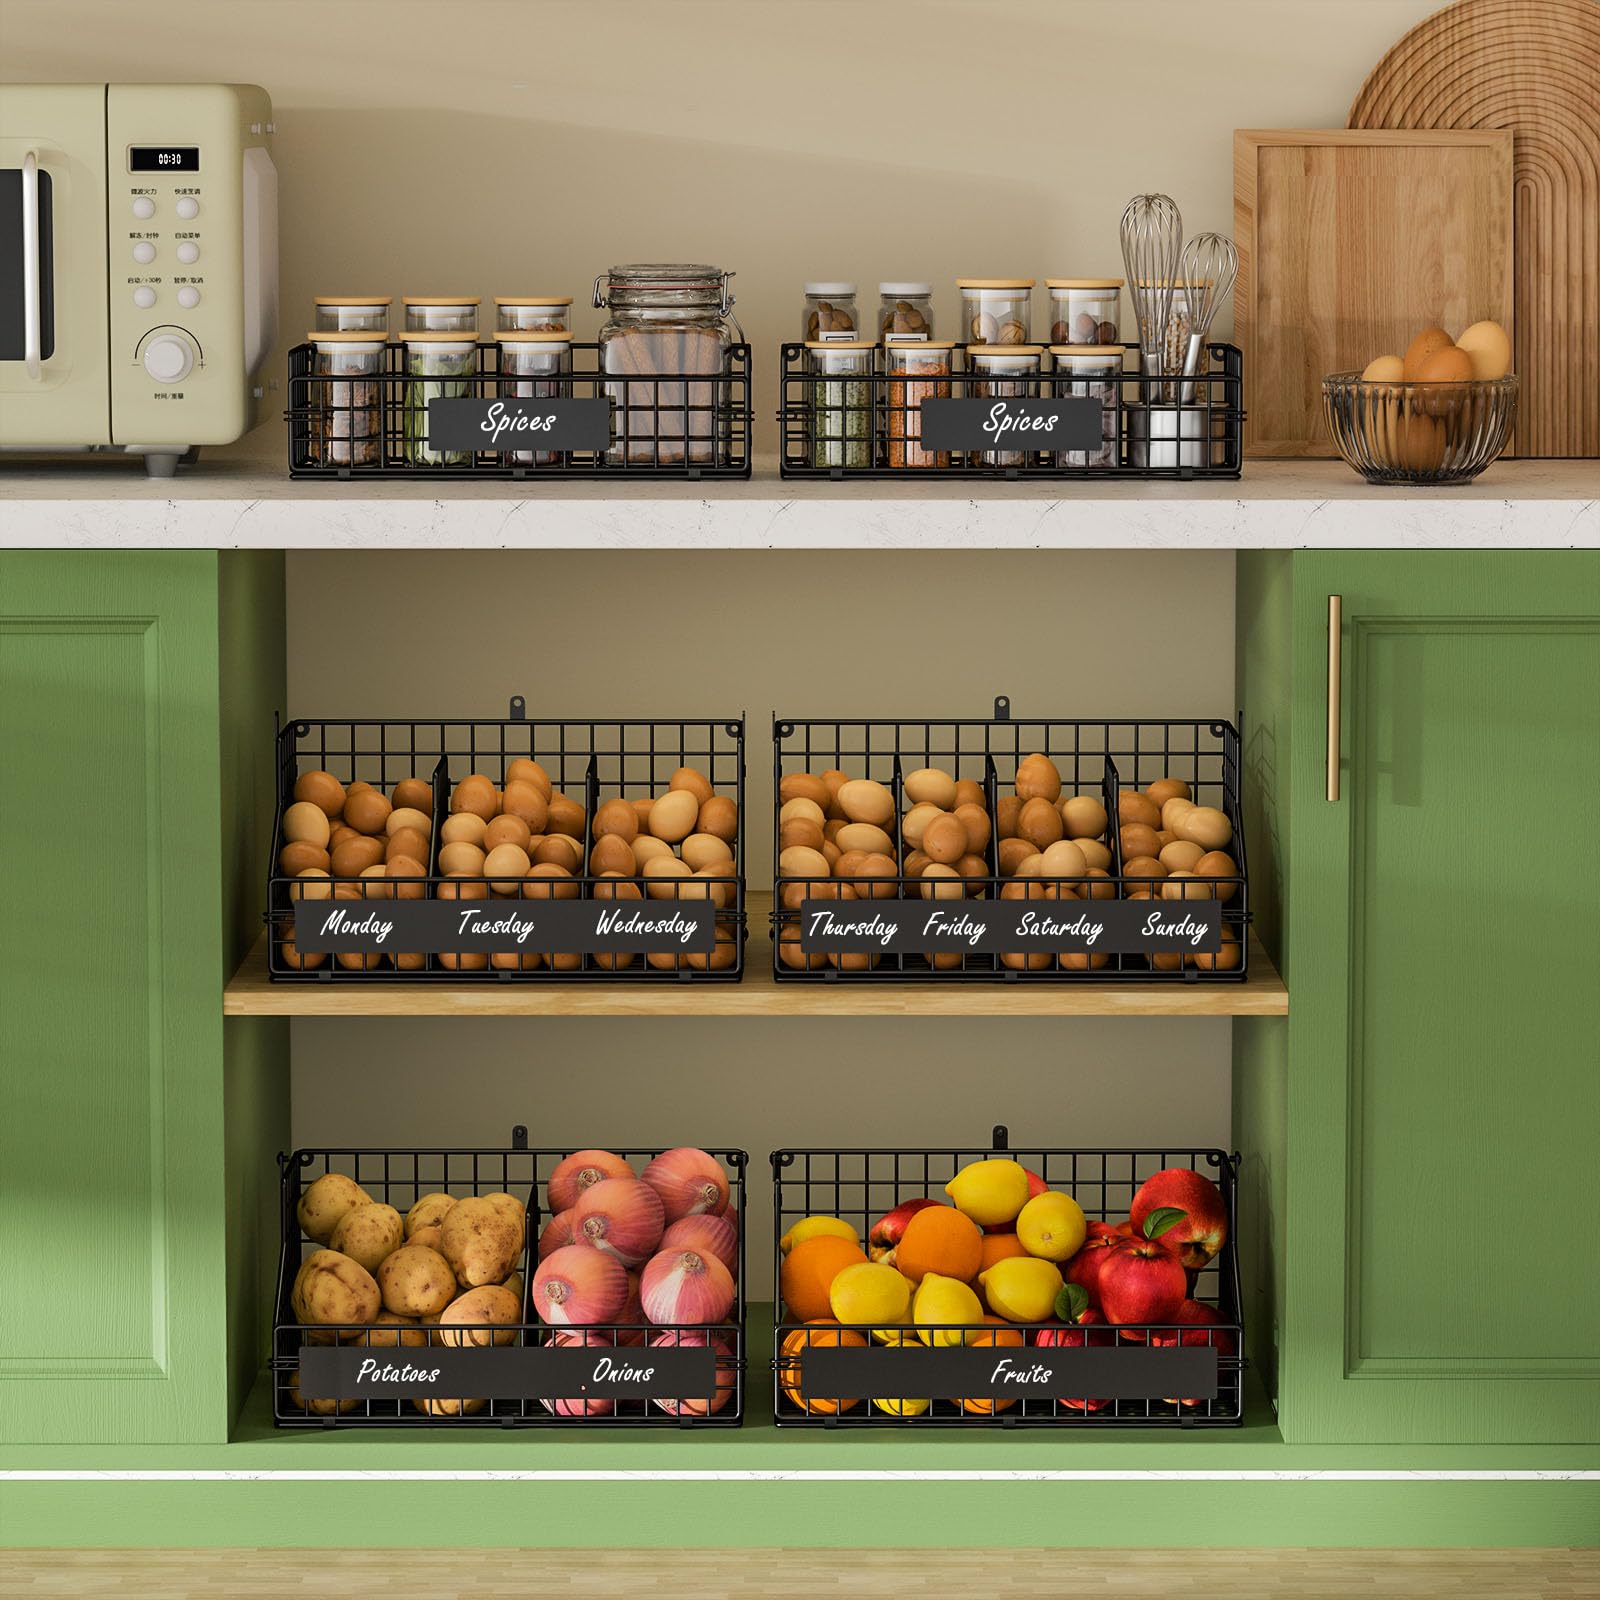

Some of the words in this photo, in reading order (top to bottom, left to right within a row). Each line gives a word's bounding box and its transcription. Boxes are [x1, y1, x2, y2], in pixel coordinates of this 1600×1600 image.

[159, 154, 181, 165] 00:30
[173, 276, 204, 284] 暂停/取消
[154, 392, 184, 400] 时间/重量
[481, 403, 557, 443] Spices
[983, 403, 1059, 443] Spices
[320, 910, 393, 943] Monday
[459, 910, 535, 943] Tuesday
[596, 909, 698, 943] Wednesday
[810, 912, 898, 945] Thursday
[923, 912, 987, 945] Friday
[1016, 912, 1104, 945] Saturday
[1142, 912, 1209, 945] Sunday
[357, 1359, 441, 1384] Potatoes
[593, 1358, 655, 1383] Onions
[991, 1359, 1053, 1384] Fruits
